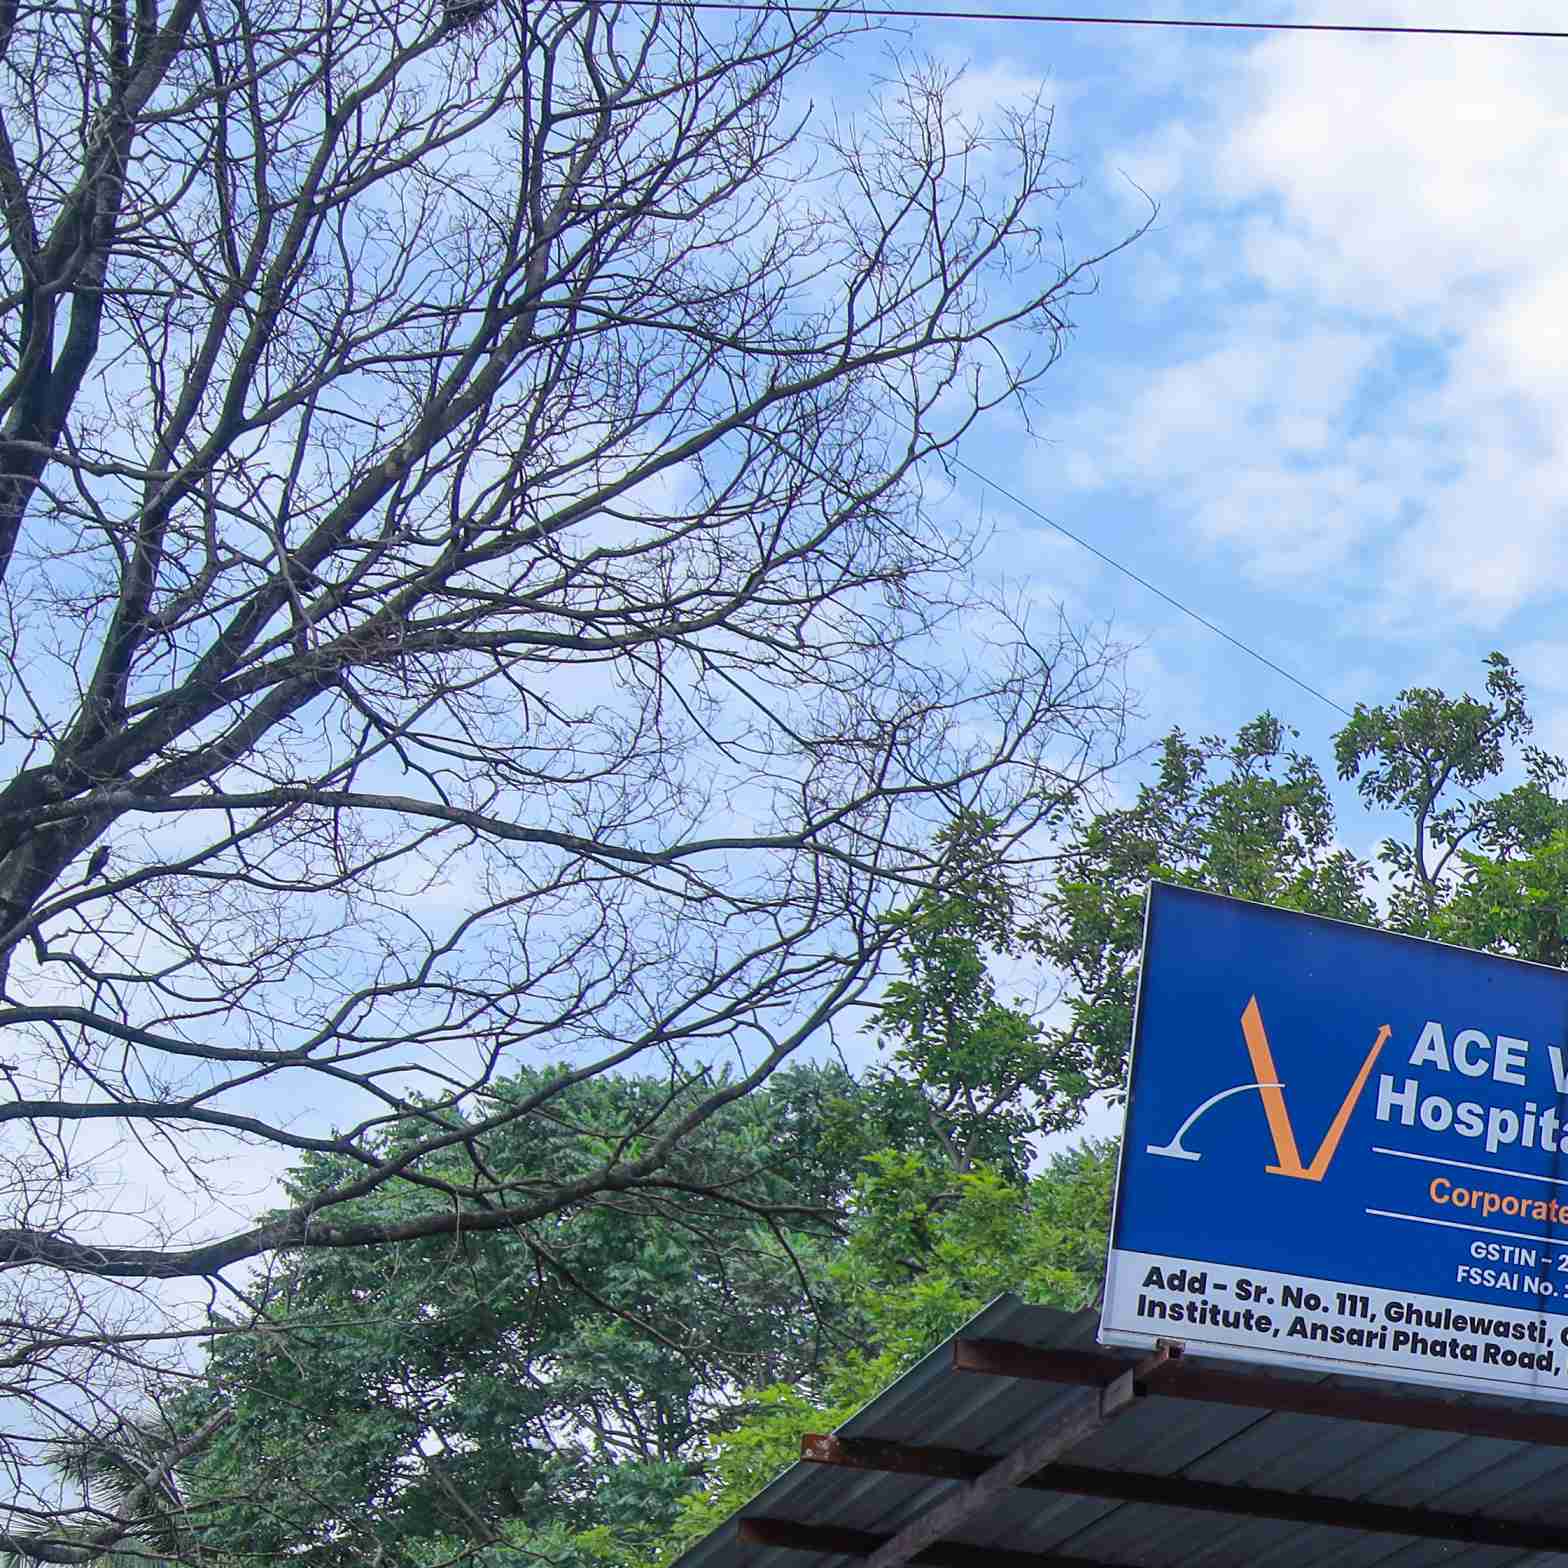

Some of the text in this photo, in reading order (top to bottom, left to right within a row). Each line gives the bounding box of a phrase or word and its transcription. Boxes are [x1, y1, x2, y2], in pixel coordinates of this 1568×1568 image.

[1408, 1020, 1529, 1086] ACE
[1456, 1265, 1518, 1292] FSSAI
[1523, 1276, 1559, 1298] No.
[1470, 1240, 1537, 1267] GSTIN
[1137, 1294, 1280, 1338] Institute,
[1287, 1316, 1388, 1350] Ansari
[1392, 1330, 1478, 1362] Phata
[1483, 1342, 1561, 1376] Road,
[1142, 1265, 1208, 1295] Add
[1235, 1278, 1275, 1305] Sr.
[1281, 1285, 1330, 1313] No.
[1336, 1292, 1377, 1322] 111,
[1384, 1301, 1553, 1347] Ghulewasti,
